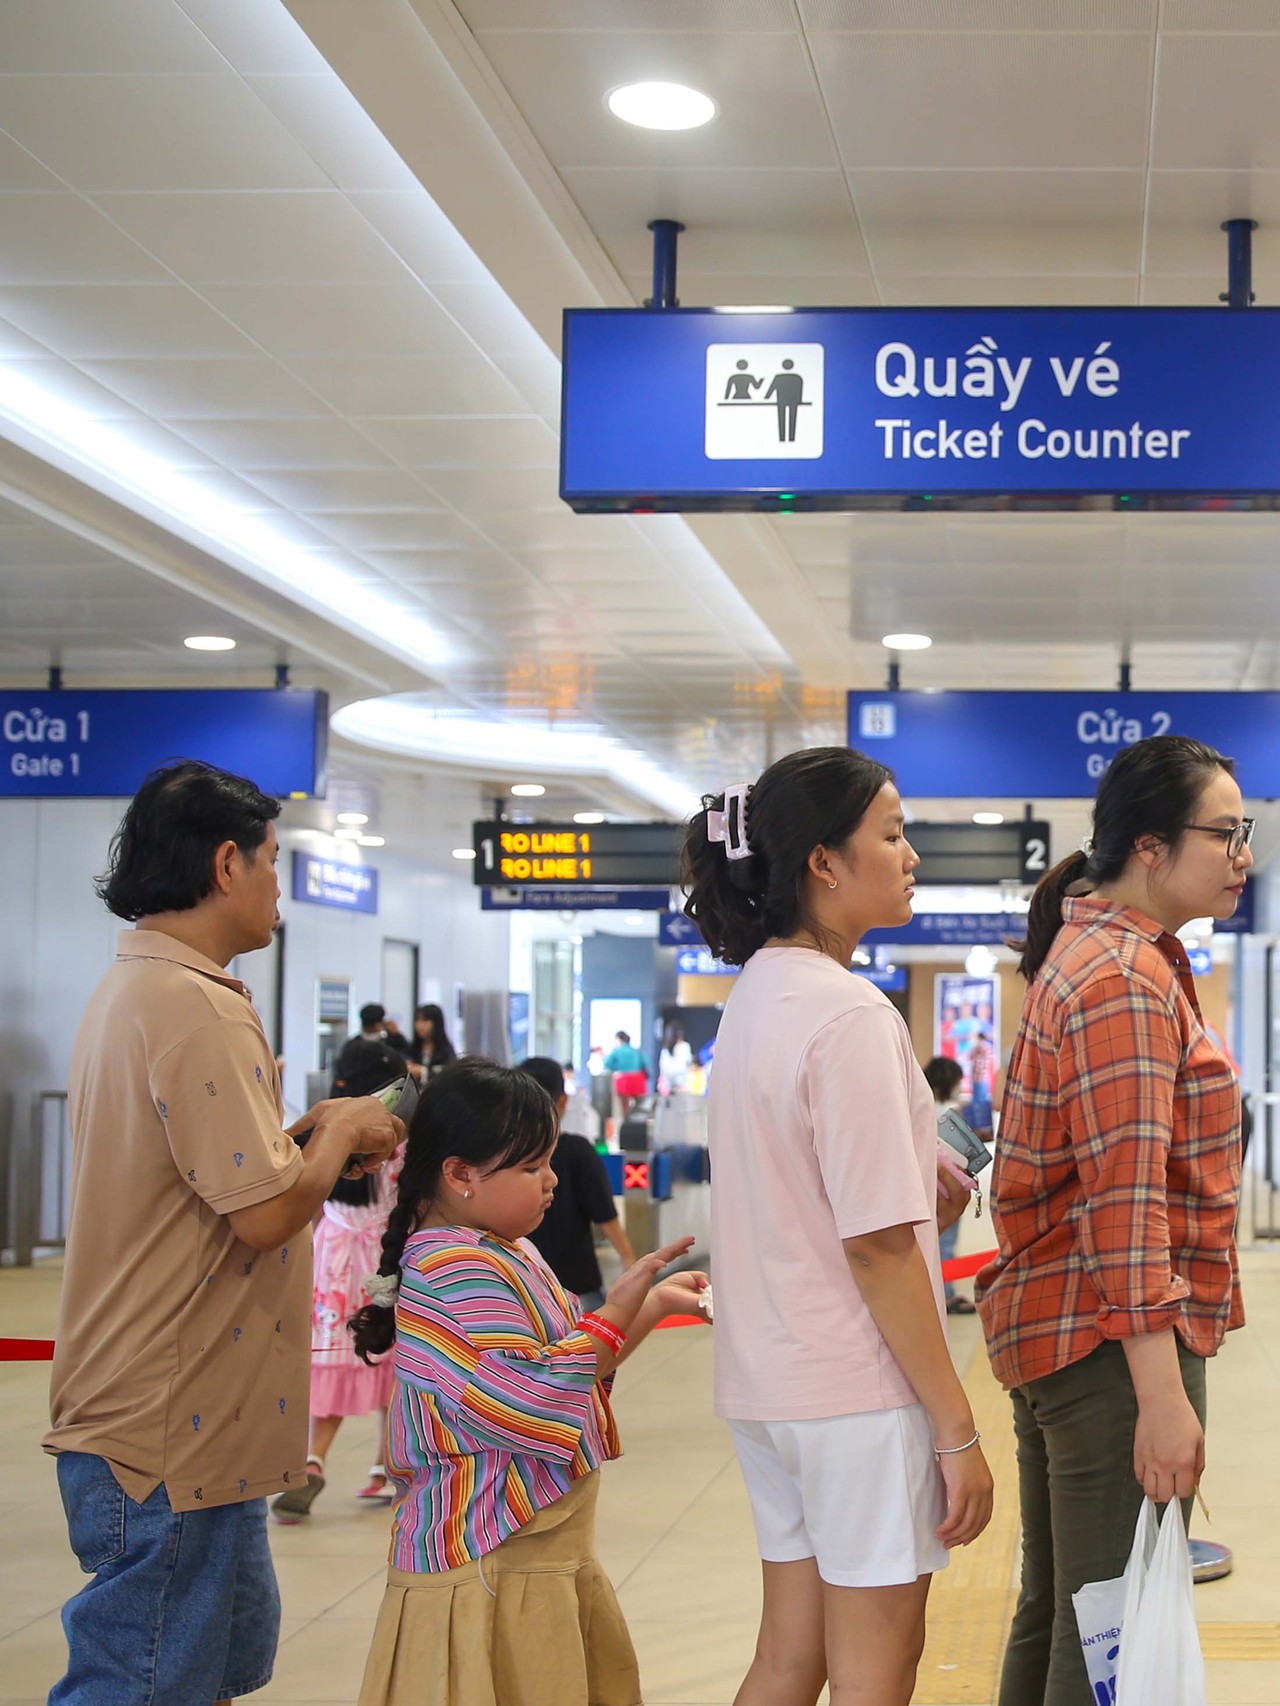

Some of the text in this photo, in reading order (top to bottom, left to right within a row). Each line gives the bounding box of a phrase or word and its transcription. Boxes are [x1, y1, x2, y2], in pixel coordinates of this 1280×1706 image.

[875, 337, 1119, 411] Quầy vé
[874, 419, 1190, 459] Ticket Counter
[3, 707, 89, 742] Cửa 1
[1077, 708, 1172, 744] Cửa 2
[11, 752, 80, 777] Gate 1
[481, 838, 494, 870] 1
[531, 832, 576, 854] LINE
[579, 832, 591, 853] 1
[1025, 838, 1046, 871] 2
[532, 858, 577, 879] LINE
[580, 858, 592, 879] 1
